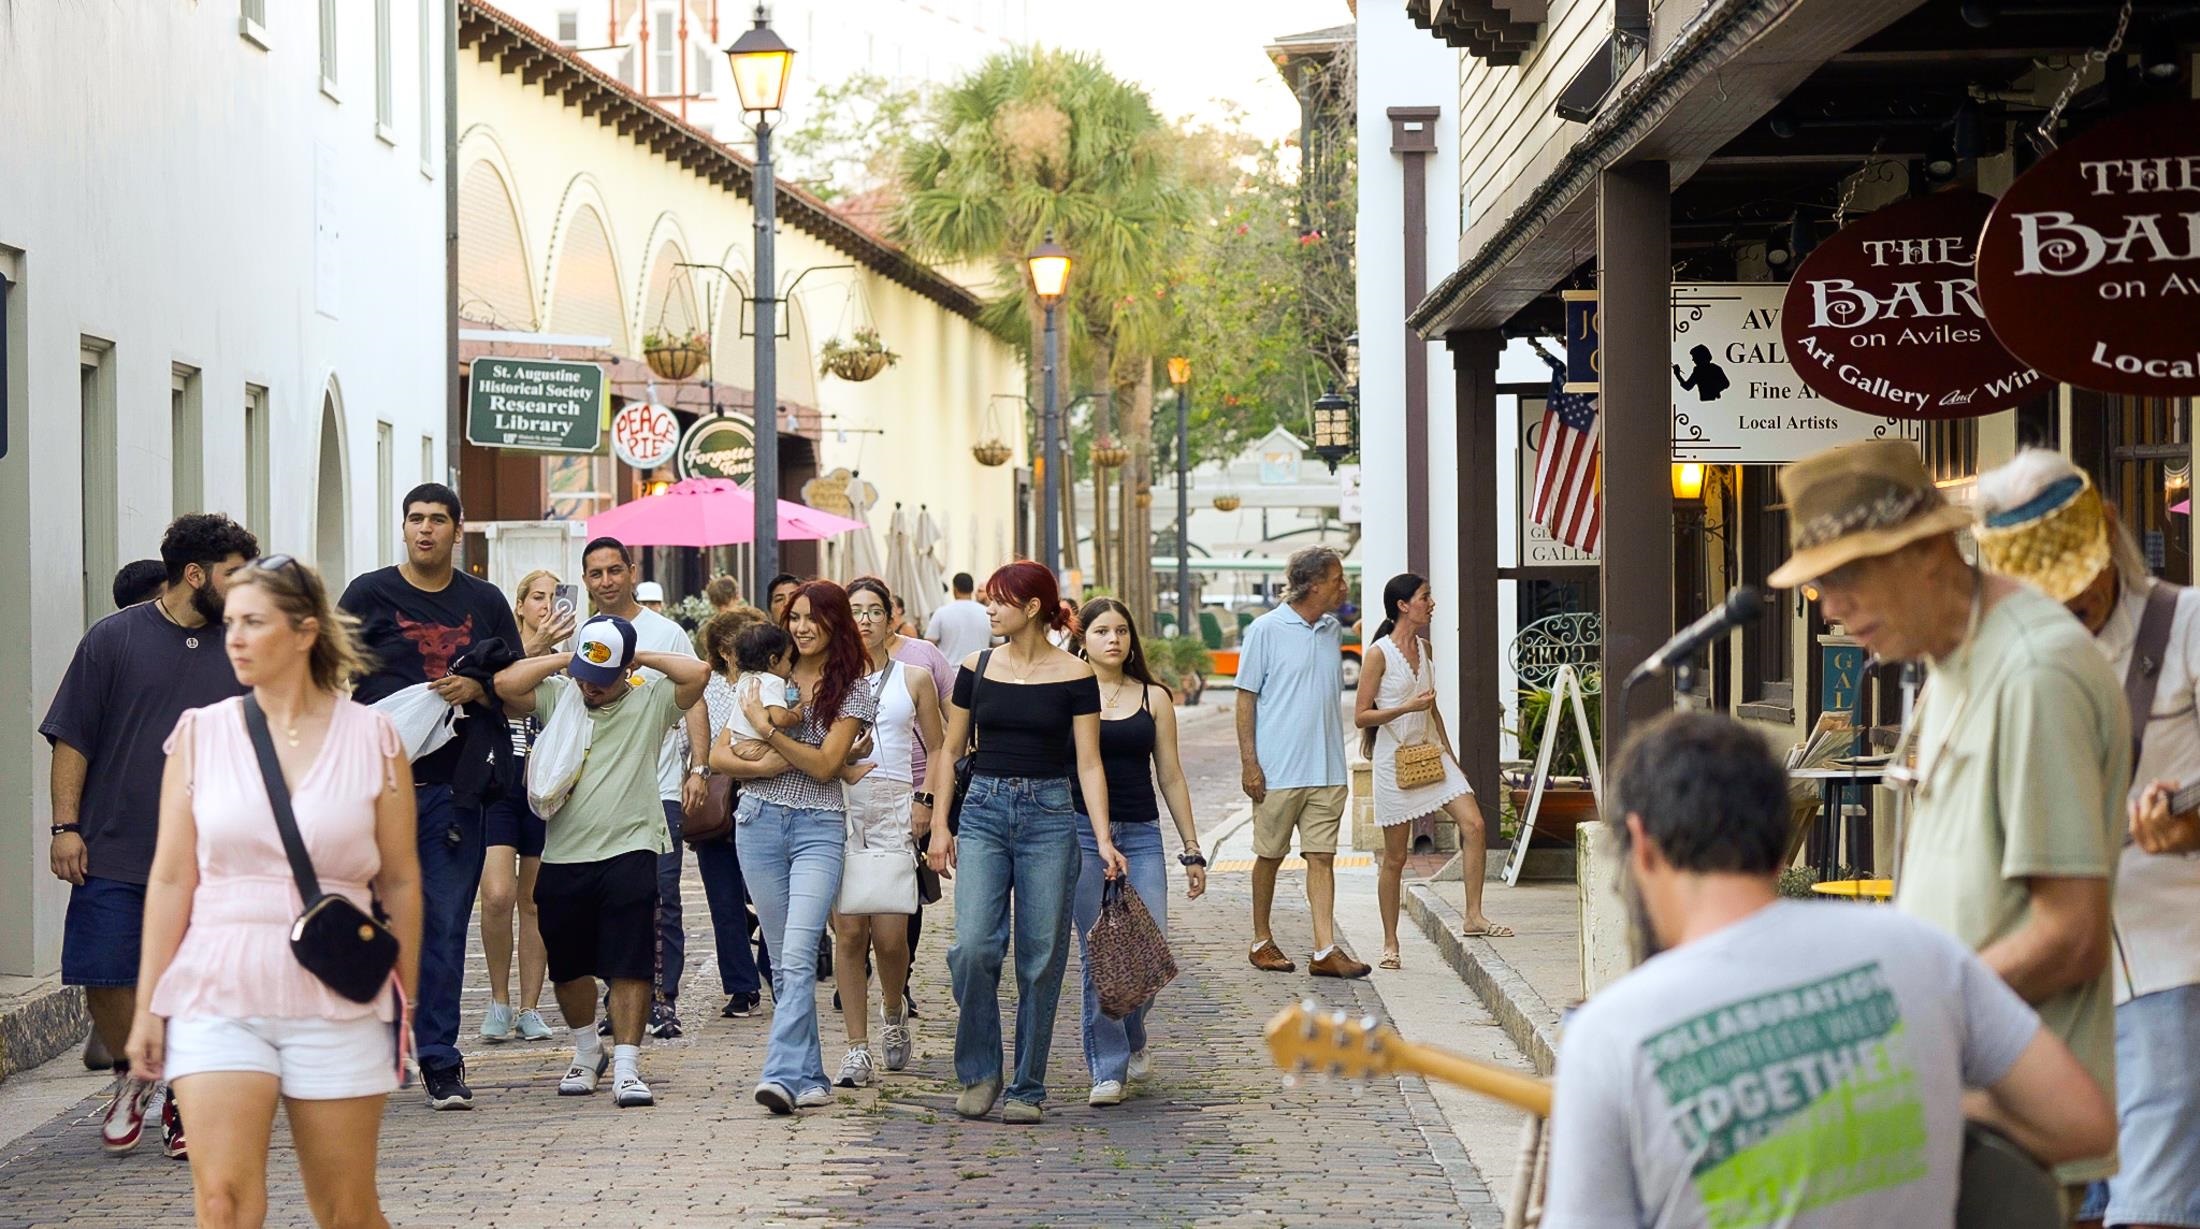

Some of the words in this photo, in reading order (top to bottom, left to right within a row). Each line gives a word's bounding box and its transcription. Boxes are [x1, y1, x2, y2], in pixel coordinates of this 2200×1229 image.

[1862, 237, 1979, 268] THE
[2099, 280, 2147, 299] on
[1805, 278, 1987, 329] BAR
[1741, 308, 1780, 330] AV
[1850, 333, 1887, 348] on
[1896, 324, 1982, 346] Aviles
[1725, 341, 1791, 364] GAL
[492, 365, 512, 379] St.
[514, 367, 581, 383] Augustine
[1797, 335, 1835, 370] Art
[1837, 363, 1931, 412] Gallery
[1983, 367, 2041, 399] Win
[479, 380, 544, 396] Historical
[545, 383, 593, 402] Society
[1749, 381, 1792, 399] Fine
[489, 395, 580, 416] Research
[495, 414, 574, 437] Library
[616, 404, 676, 444] PEACE
[1739, 415, 1781, 430] Local
[1786, 415, 1839, 430] Artists
[627, 437, 664, 459] PIE
[684, 447, 754, 469] Forgotte
[719, 459, 754, 476] Toni
[1833, 652, 1854, 709] GAL
[1664, 1041, 1890, 1149] TOGETHE
